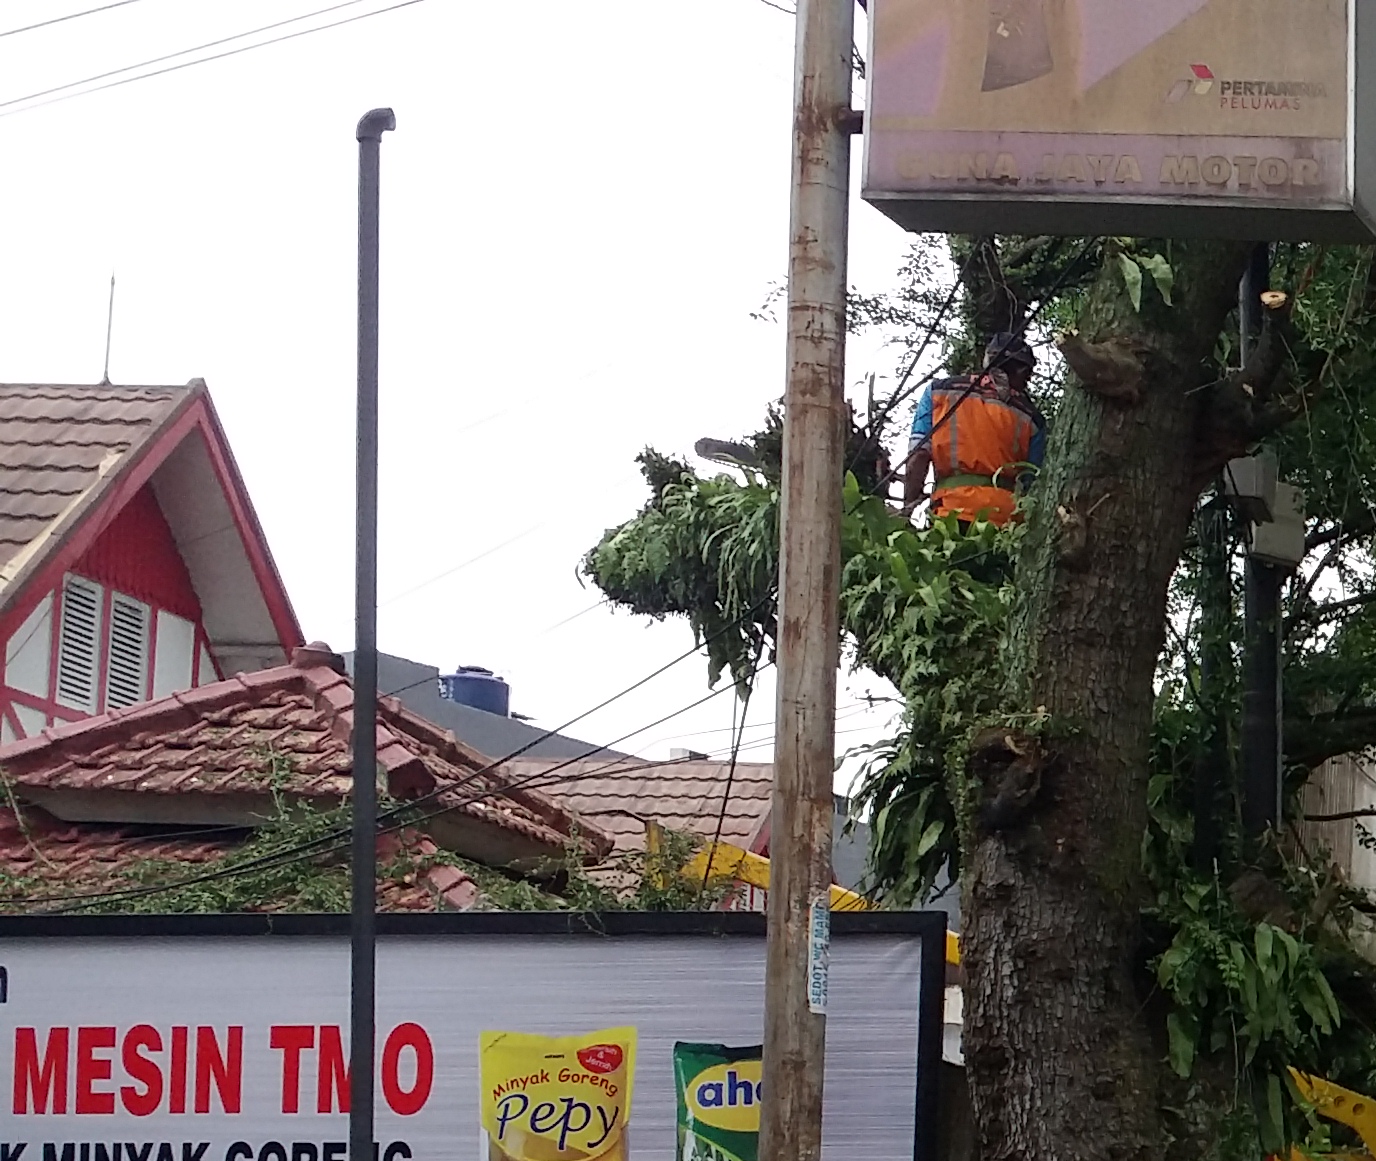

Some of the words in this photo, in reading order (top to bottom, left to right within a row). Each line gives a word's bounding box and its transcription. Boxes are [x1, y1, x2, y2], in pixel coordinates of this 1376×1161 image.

[1220, 97, 1301, 110] PELUMAS
[1158, 154, 1321, 188] MOTOR
[811, 964, 822, 1005] SEDOT
[12, 1024, 244, 1117] MESIN
[492, 1068, 550, 1102] Minyak
[558, 1067, 619, 1098] Goreng
[696, 1071, 763, 1107] ah
[496, 1093, 620, 1151] Pepy
